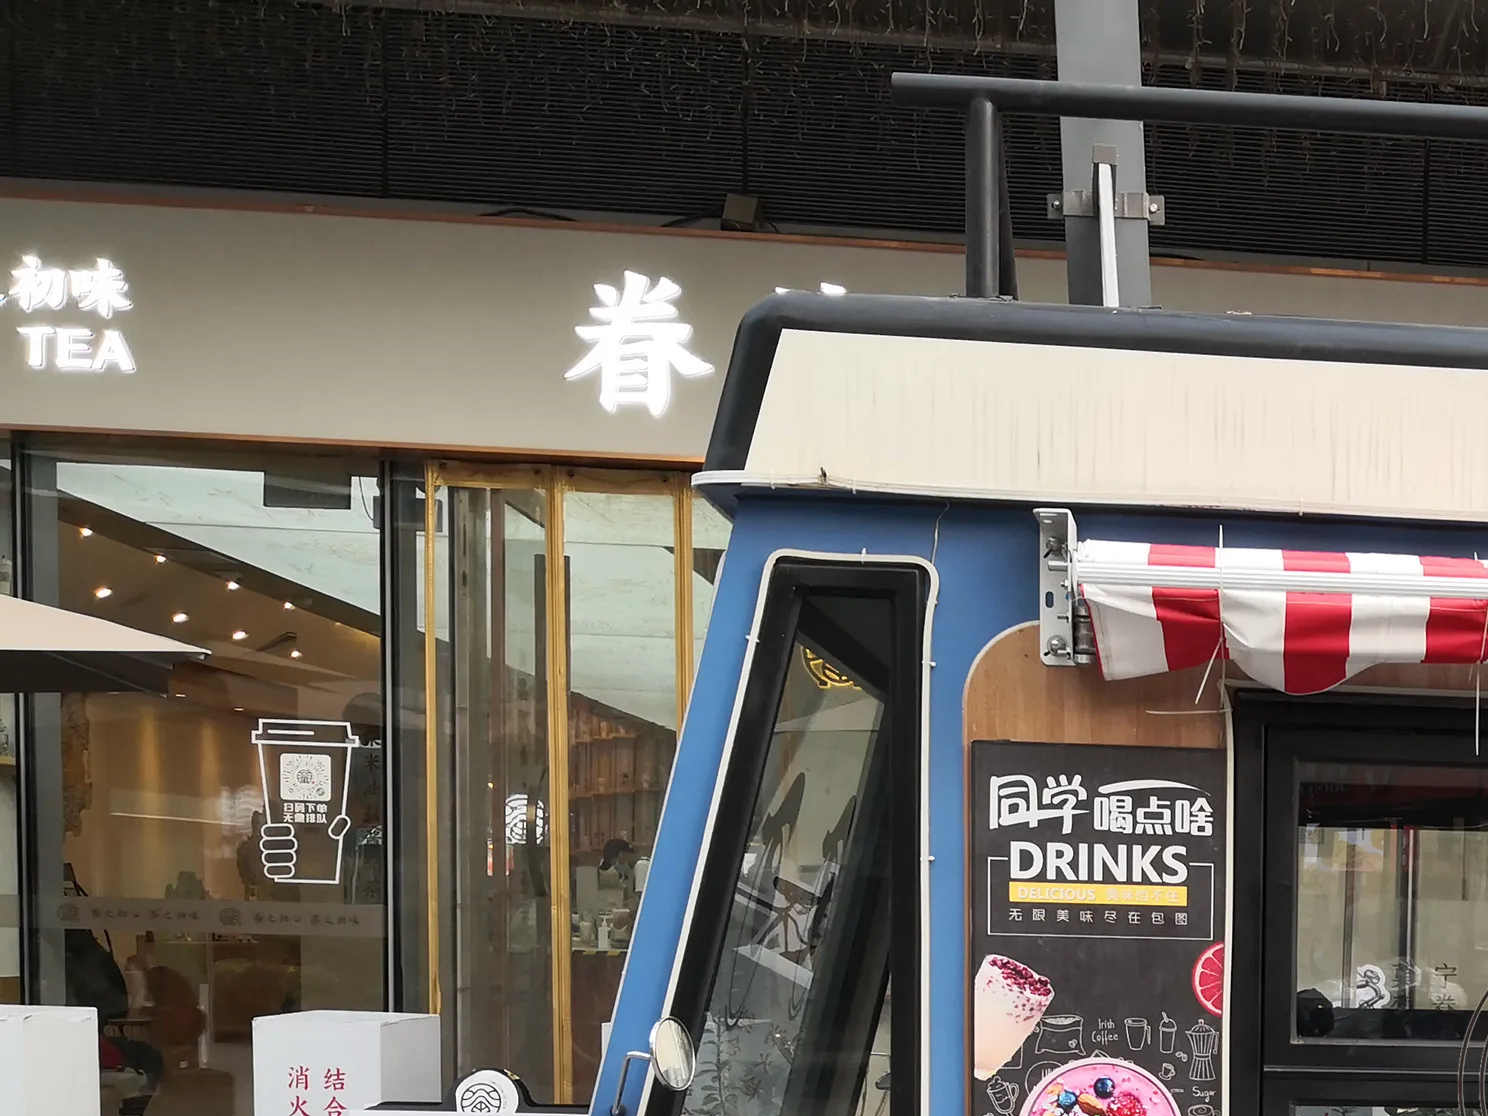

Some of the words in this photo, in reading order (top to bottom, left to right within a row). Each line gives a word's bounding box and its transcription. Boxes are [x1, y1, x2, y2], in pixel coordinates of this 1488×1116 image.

[16, 326, 138, 373] TEA
[989, 774, 1090, 834] 同学
[1093, 795, 1214, 836] 喝点啥
[1010, 840, 1189, 884] DRINKS
[1017, 886, 1096, 901] DELICIOUS
[1008, 908, 1188, 926] 无限美味尽在包图
[1098, 1019, 1115, 1030] Irish
[1092, 1031, 1120, 1046] Coffee
[1192, 1086, 1217, 1102] Sugar
